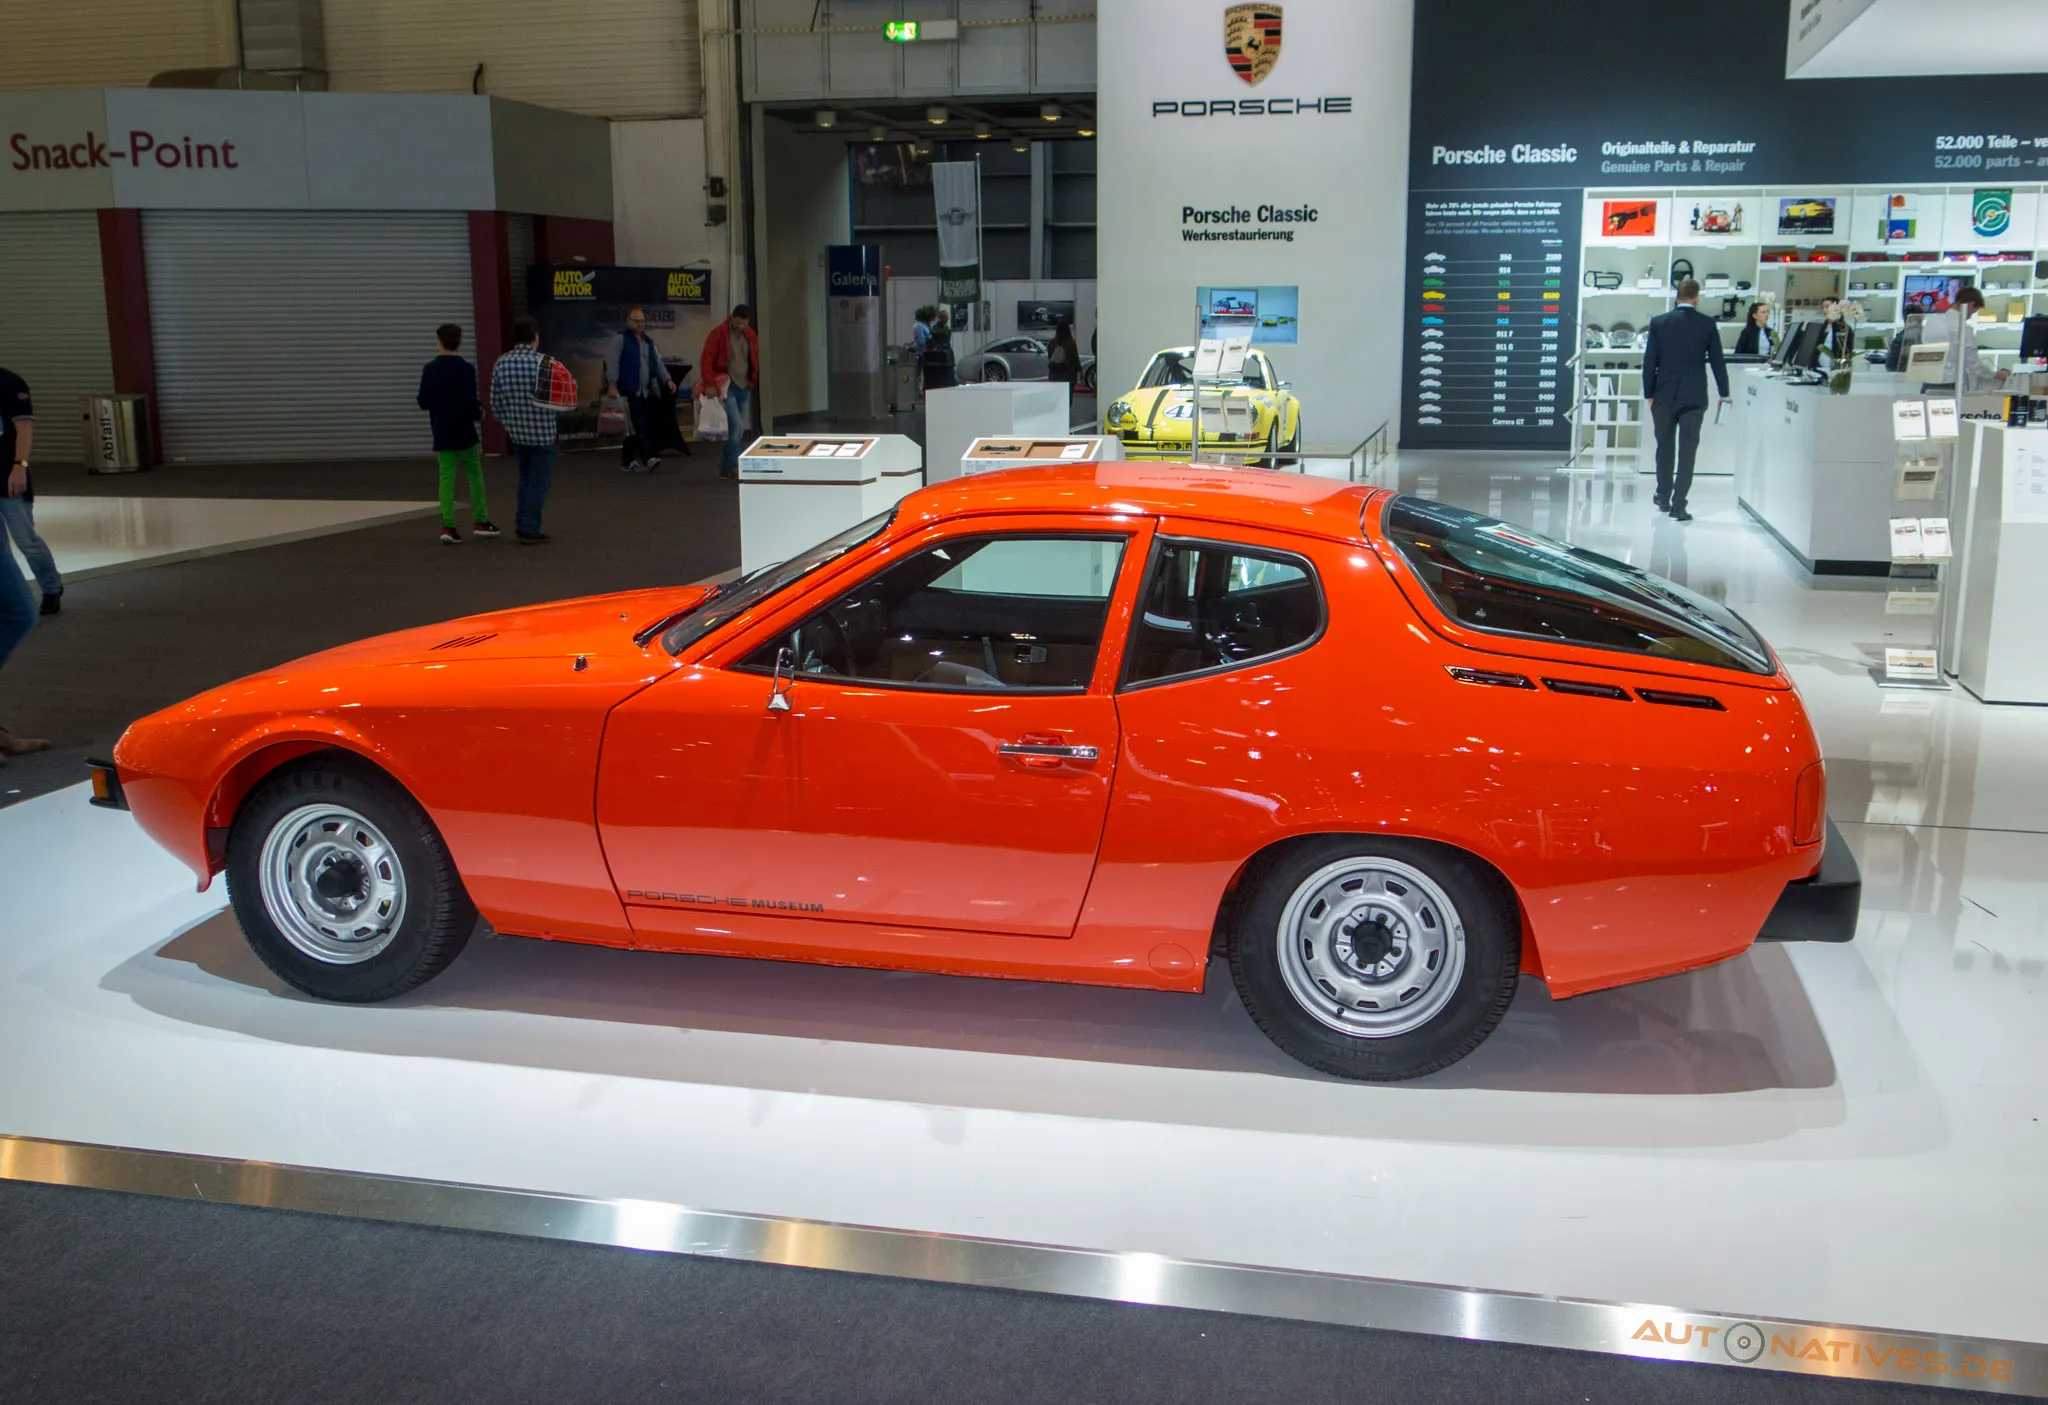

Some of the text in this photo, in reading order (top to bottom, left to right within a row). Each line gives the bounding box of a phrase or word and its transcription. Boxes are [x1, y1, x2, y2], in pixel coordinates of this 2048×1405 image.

[1225, 3, 1283, 16] PORSCHE
[1152, 97, 1352, 118] PORSCHE
[1602, 140, 1756, 157] Originalteile & Reparatur
[1935, 135, 1984, 150] 52.000
[1987, 135, 2018, 149] Teile
[2034, 137, 2048, 148] ve
[10, 130, 239, 171] Snack-Point
[1432, 143, 1578, 164] Porsche Classic
[1601, 158, 1746, 174] Genuine Parts & Repair
[1934, 155, 1982, 168] 52.000
[1986, 155, 2020, 169] parts
[1183, 204, 1318, 224] Porsche Classic
[1182, 228, 1294, 243] Werksrestaurierung
[554, 270, 584, 284] AUTO
[1498, 266, 1511, 274] 914
[668, 272, 695, 286] AUTO
[831, 271, 878, 287] Galeria
[553, 283, 593, 296] MOTOR
[667, 285, 701, 297] MOTOR
[1496, 330, 1508, 338] 911
[1495, 343, 1507, 351] 911
[1960, 410, 2002, 421] rsche
[101, 418, 116, 462] Abfall
[626, 890, 824, 913] PORSCHE MUSEUM
